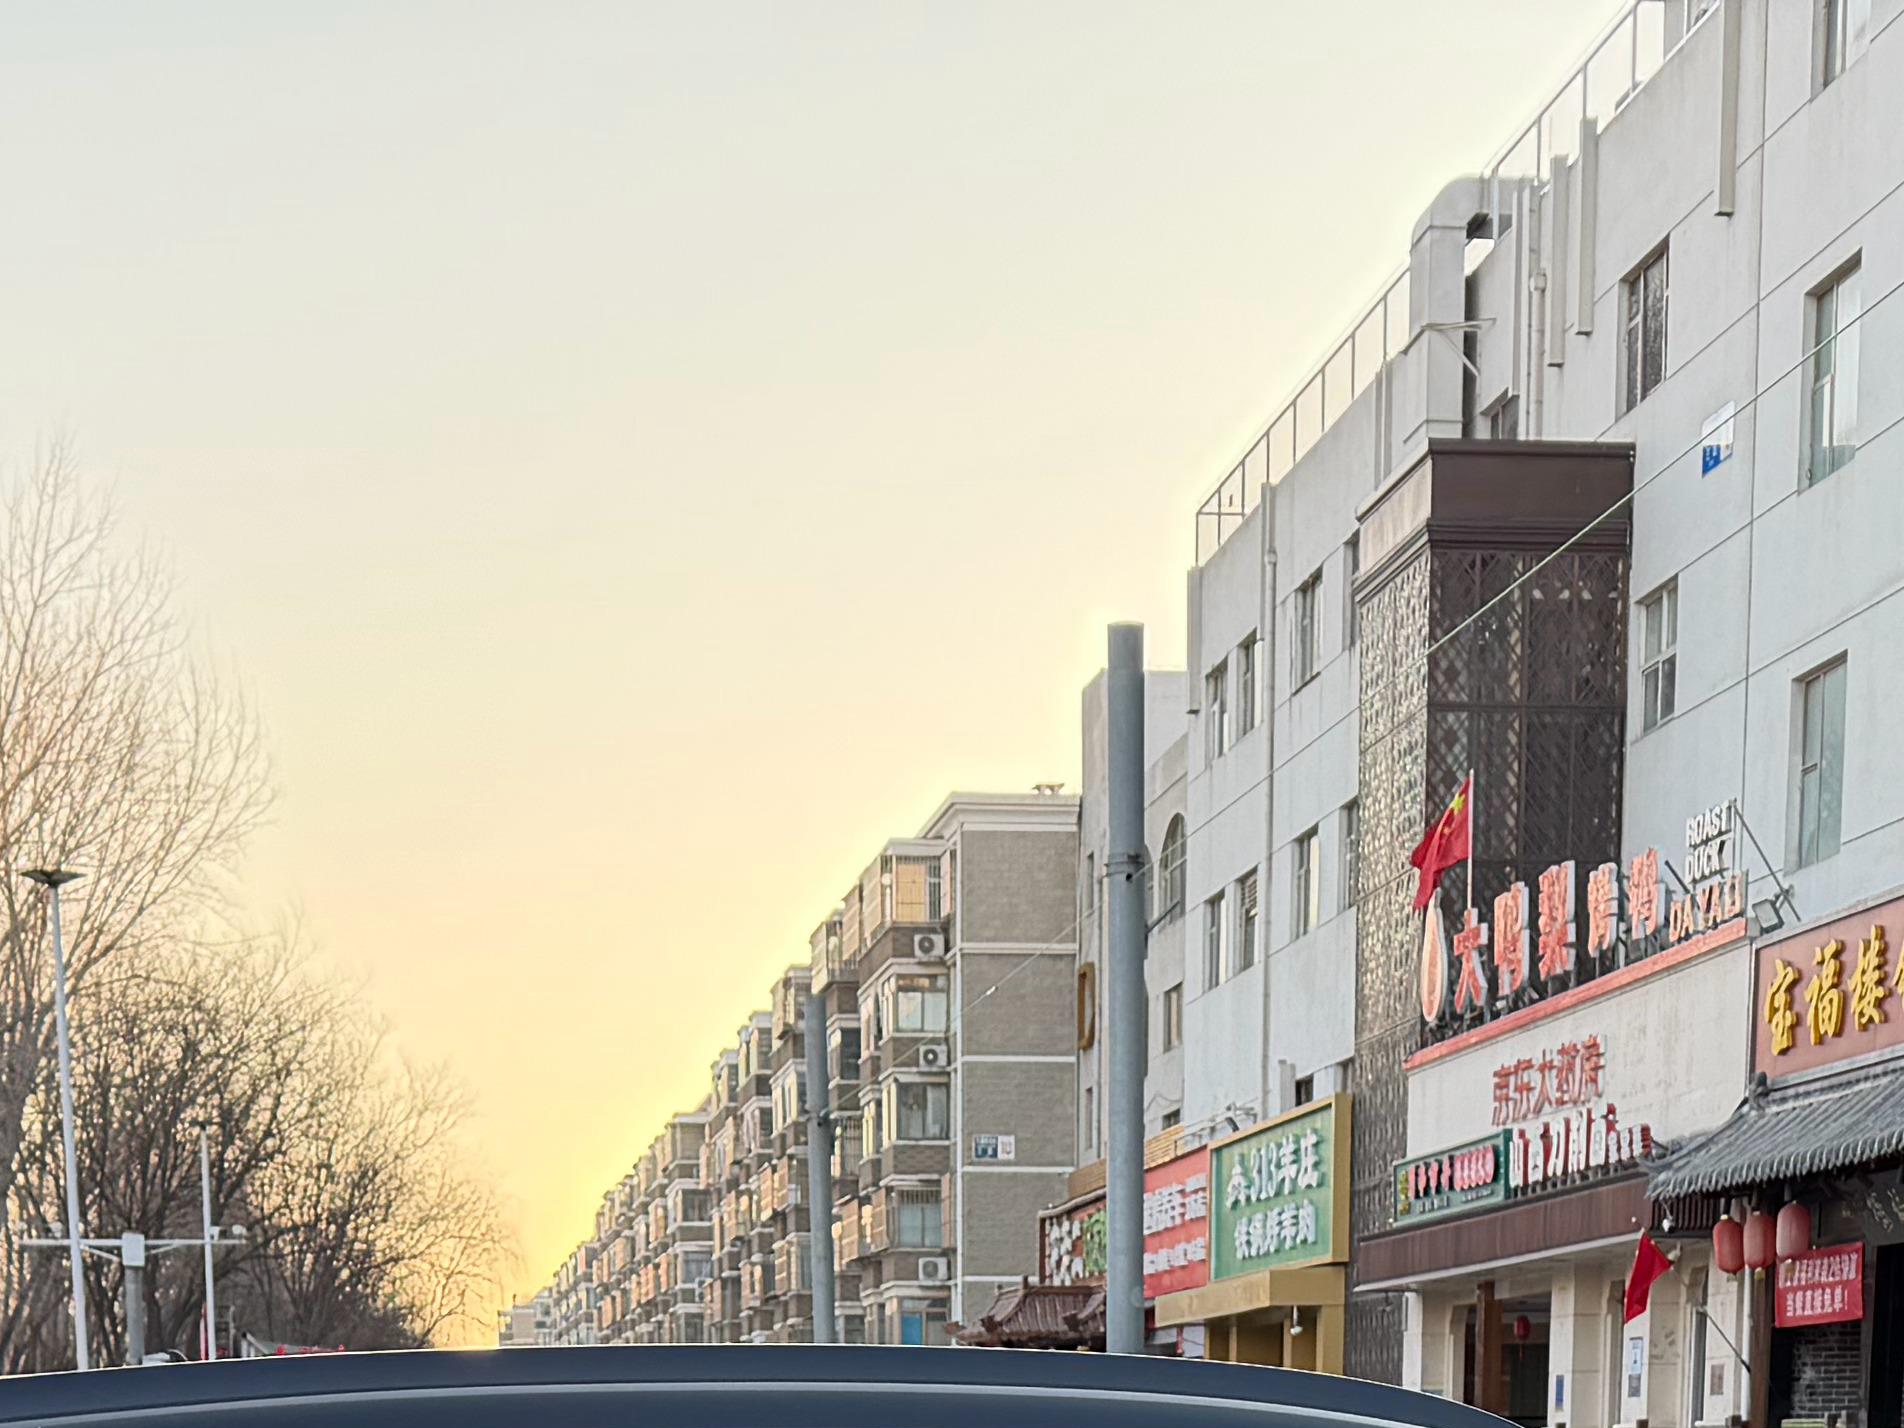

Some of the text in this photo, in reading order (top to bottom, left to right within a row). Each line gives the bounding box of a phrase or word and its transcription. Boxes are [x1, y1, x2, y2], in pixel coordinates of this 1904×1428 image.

[1685, 799, 1733, 848] ROAST
[1684, 838, 1728, 884] DUCK
[1453, 846, 1666, 1014] 大鸭梨烤鸭
[1492, 1032, 1606, 1128] 京东大药房
